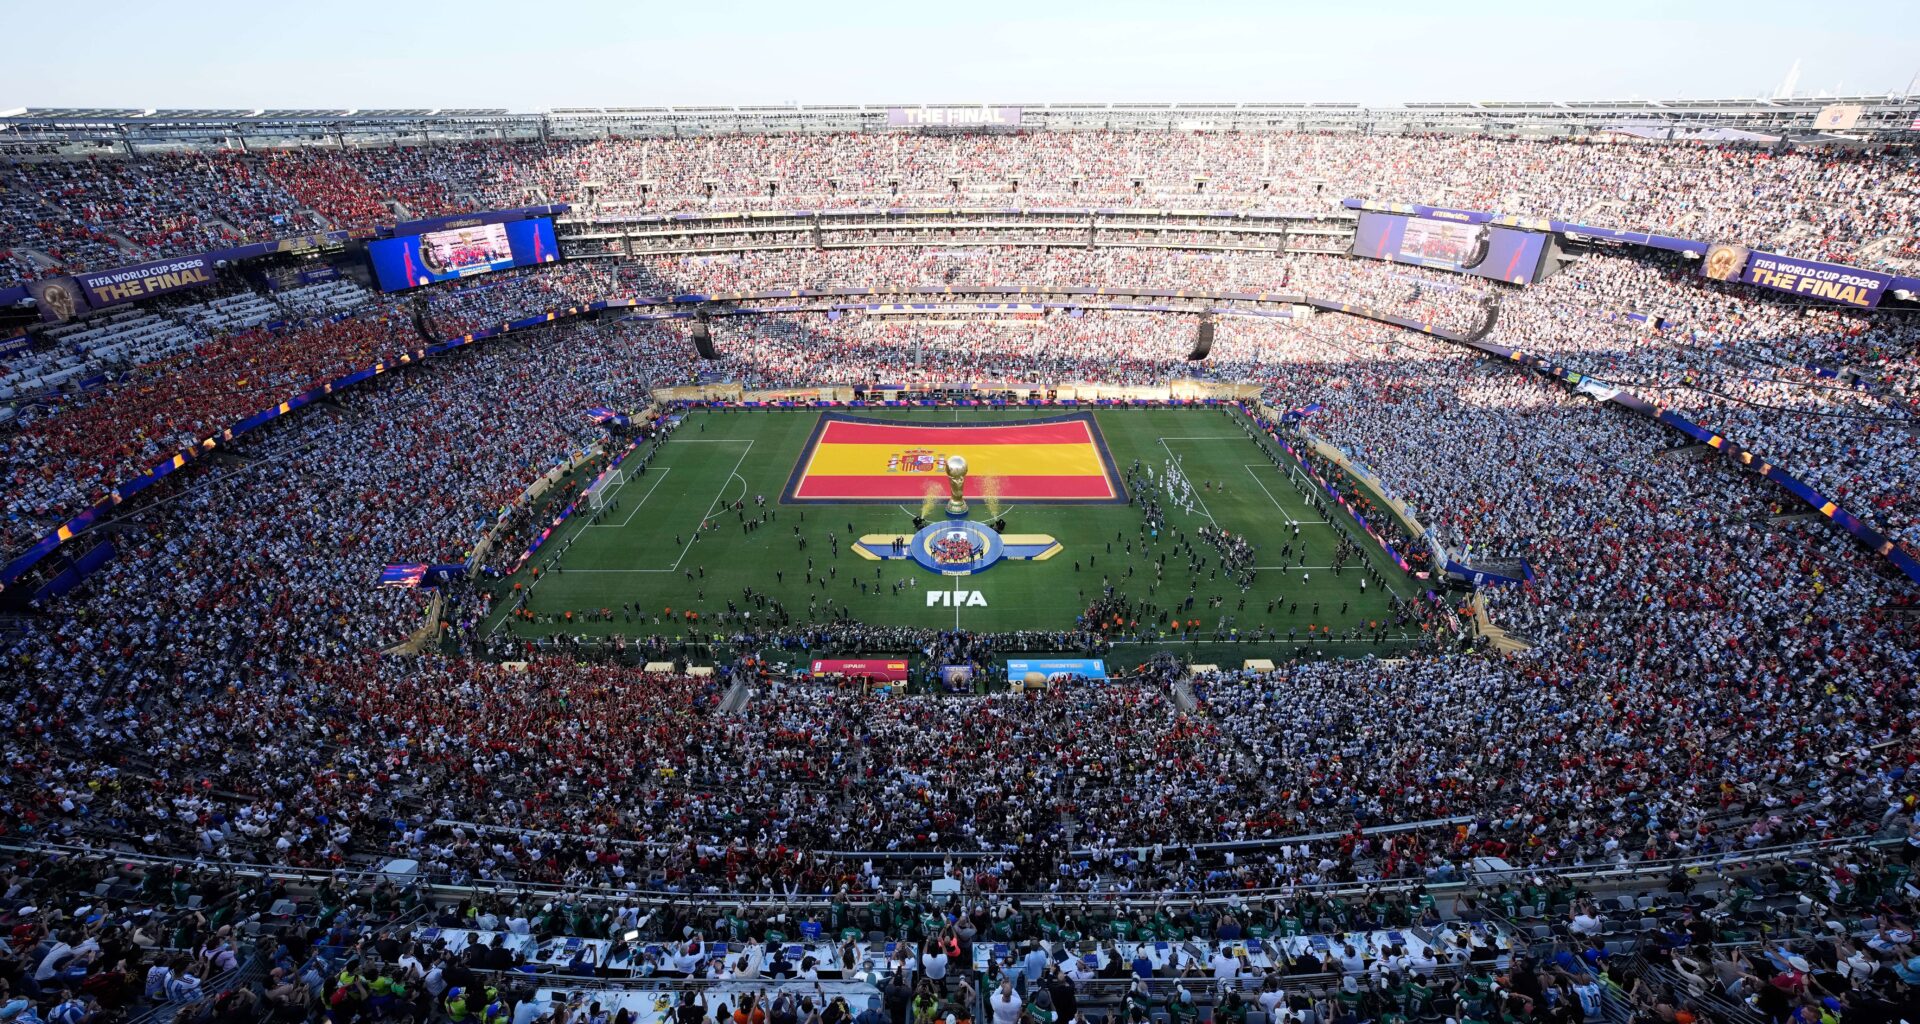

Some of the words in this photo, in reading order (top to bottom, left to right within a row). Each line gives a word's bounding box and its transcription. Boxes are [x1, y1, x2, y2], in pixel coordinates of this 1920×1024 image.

[905, 108, 943, 123] THE
[947, 108, 1005, 123] FINAL
[87, 276, 111, 288] FIFA
[111, 269, 150, 284] WORLD
[150, 265, 170, 276] CUP
[169, 259, 204, 272] 2026
[92, 280, 144, 302] THE
[144, 268, 210, 293] FINAL
[1752, 267, 1797, 290] THE
[1797, 276, 1871, 307] FINAL
[1754, 259, 1776, 271] FIFA
[1777, 262, 1816, 279] WORLD
[1816, 270, 1840, 281] CUP
[1839, 274, 1880, 290] 2026
[926, 590, 988, 607] FIFA
